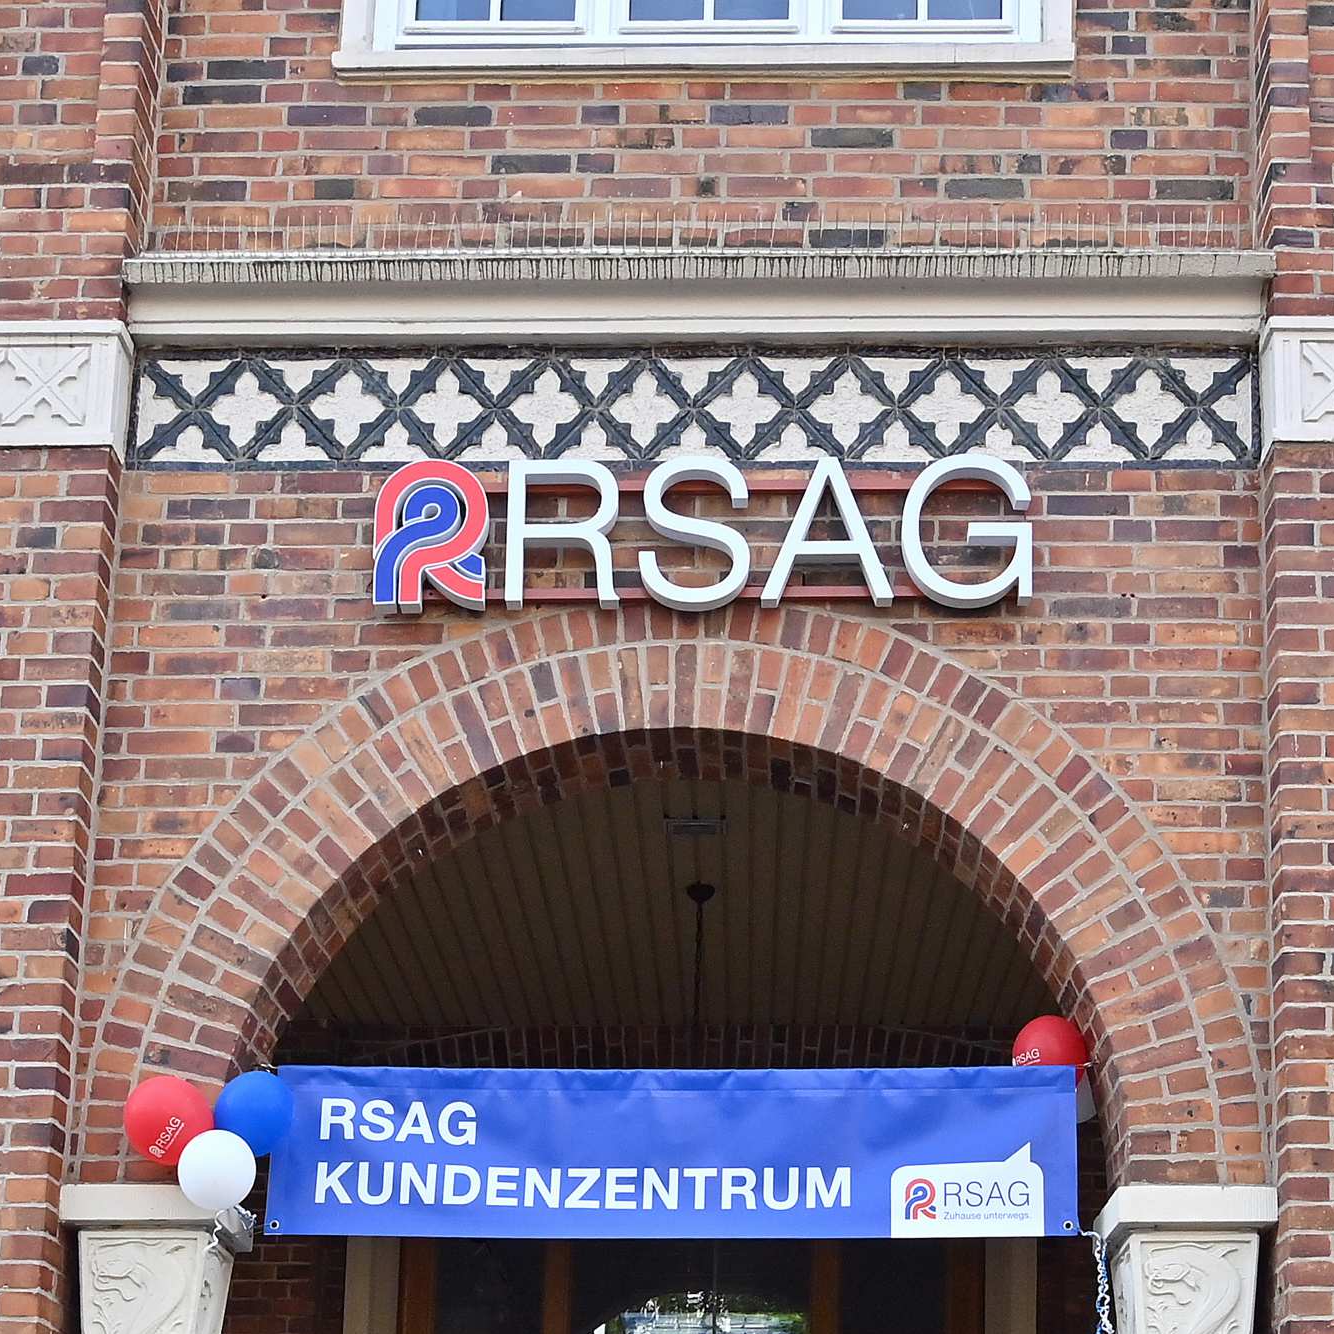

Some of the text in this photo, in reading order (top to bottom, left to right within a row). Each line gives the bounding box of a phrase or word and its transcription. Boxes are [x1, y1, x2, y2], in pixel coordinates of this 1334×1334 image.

[504, 453, 1034, 612] RSAG
[155, 1116, 182, 1150] RSAG
[318, 1097, 477, 1146] RSAG
[314, 1160, 852, 1211] KUNDENZENTRUM
[943, 1180, 1030, 1207] RSAG
[943, 1211, 981, 1220] Zuhause
